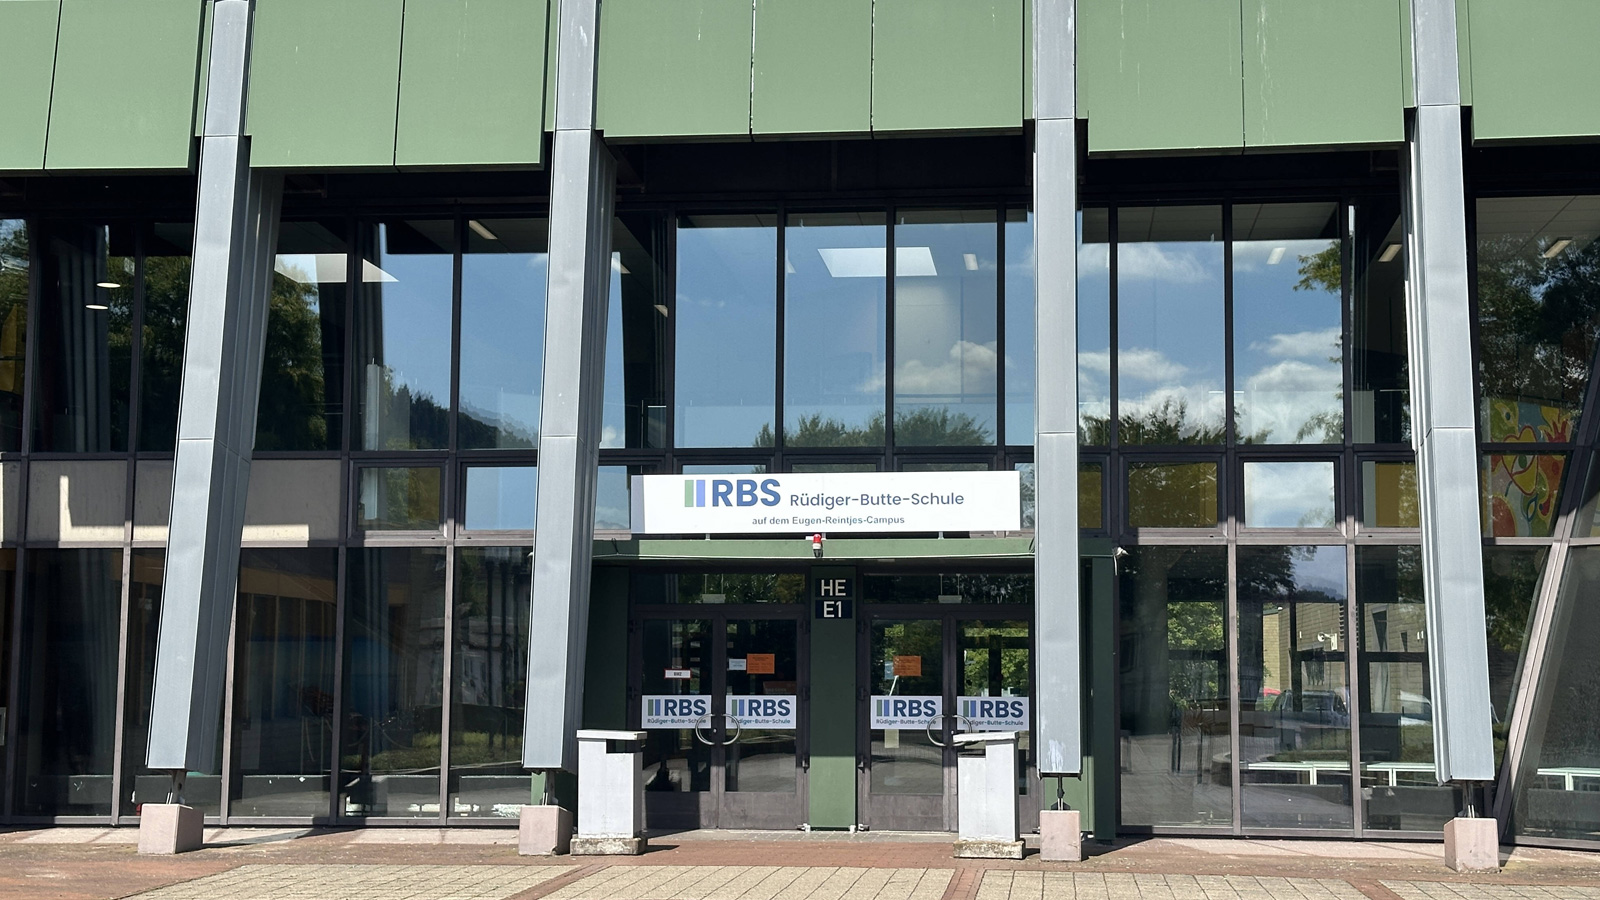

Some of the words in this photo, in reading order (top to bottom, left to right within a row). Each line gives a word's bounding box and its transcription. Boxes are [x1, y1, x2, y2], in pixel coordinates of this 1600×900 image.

[712, 478, 781, 508] RBS
[790, 492, 965, 511] Rüdiger-Butte-Schule
[751, 516, 767, 525] auf
[769, 516, 790, 525] dem
[792, 515, 905, 527] Eugen-Reintjes-Campus
[821, 579, 846, 596] HE
[823, 600, 842, 618] E1
[664, 699, 707, 717] RBS
[748, 699, 791, 717] RBS
[893, 699, 937, 718] RBS
[979, 700, 1024, 719] RBS
[731, 717, 791, 726] Rdiger-Butte-Schule
[876, 718, 937, 726] Rüdiger-Butte-Schle
[962, 719, 1024, 727] Rdiger-Butte-Schule
